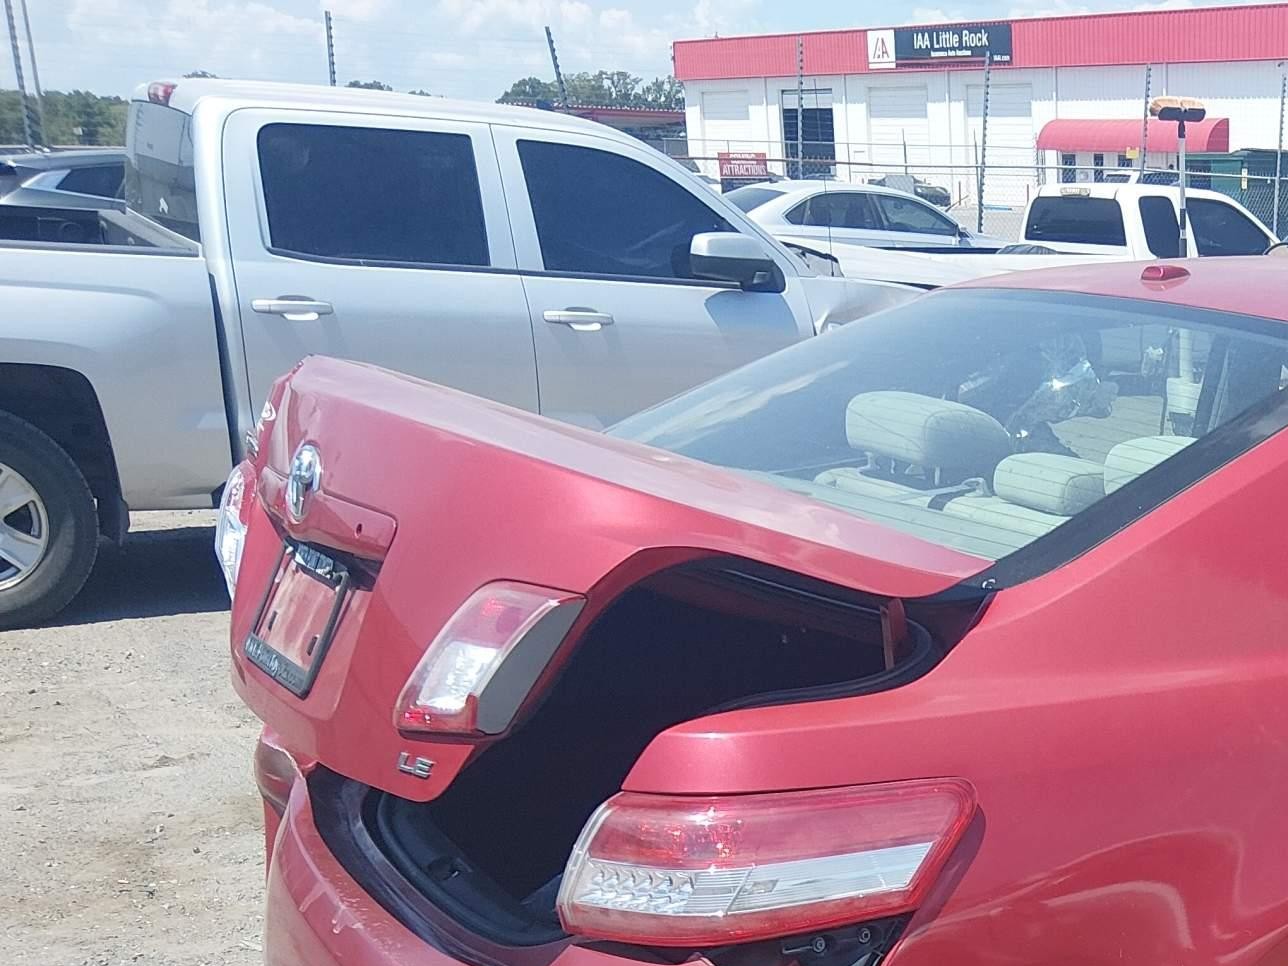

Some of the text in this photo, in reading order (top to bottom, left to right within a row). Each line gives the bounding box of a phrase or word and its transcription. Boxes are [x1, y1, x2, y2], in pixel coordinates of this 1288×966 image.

[913, 29, 989, 49] IAA Little Rock
[722, 164, 767, 176] ATTRACTIONS
[397, 751, 438, 780] LE
